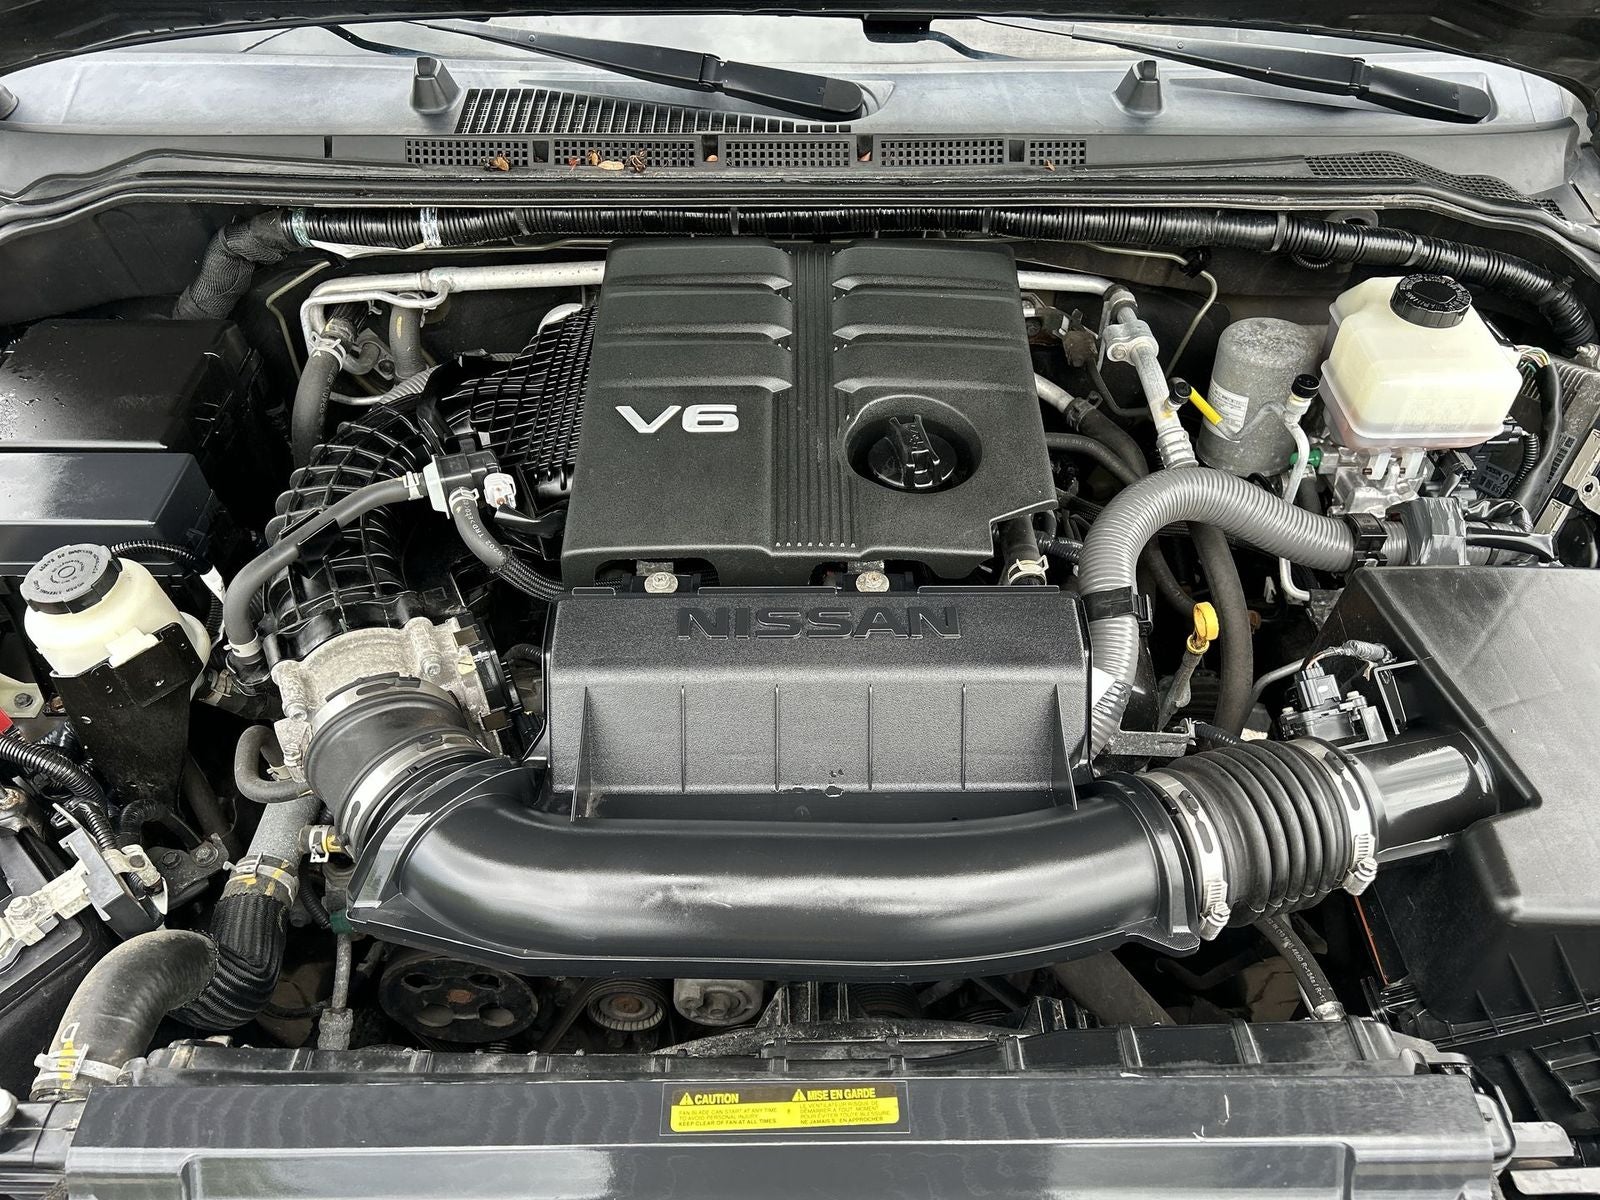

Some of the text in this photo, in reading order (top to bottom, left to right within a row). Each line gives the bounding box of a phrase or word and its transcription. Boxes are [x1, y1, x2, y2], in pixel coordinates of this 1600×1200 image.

[615, 404, 739, 433] V6
[678, 606, 961, 640] NISSAN
[694, 1093, 739, 1105] CAUTION
[807, 1087, 876, 1101] MISE EN GARDE
